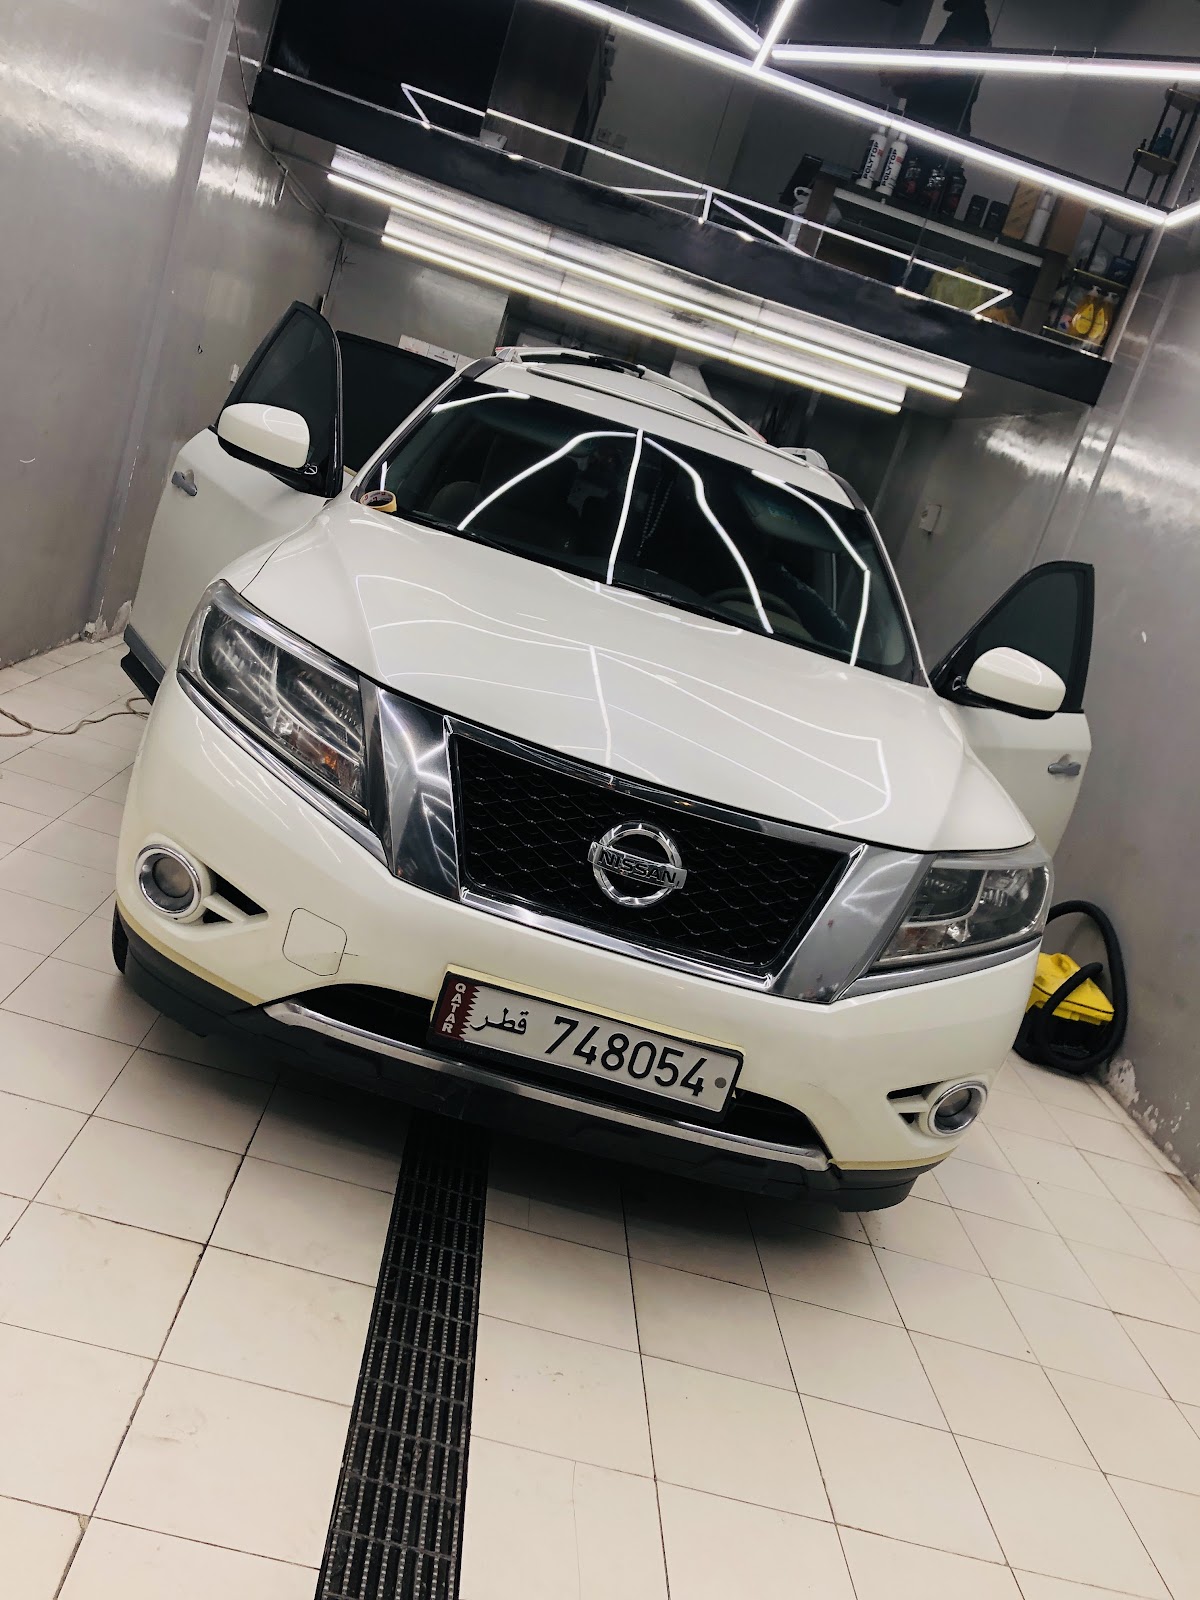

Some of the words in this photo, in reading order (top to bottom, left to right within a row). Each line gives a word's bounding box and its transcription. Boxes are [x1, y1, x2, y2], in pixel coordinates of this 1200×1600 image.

[862, 141, 879, 179] POLYTOP
[880, 149, 897, 187] POLYTOP
[600, 850, 677, 885] NISSAN
[441, 982, 467, 1034] QATAR
[469, 1007, 530, 1035] قطر
[544, 1015, 708, 1098] 748054
